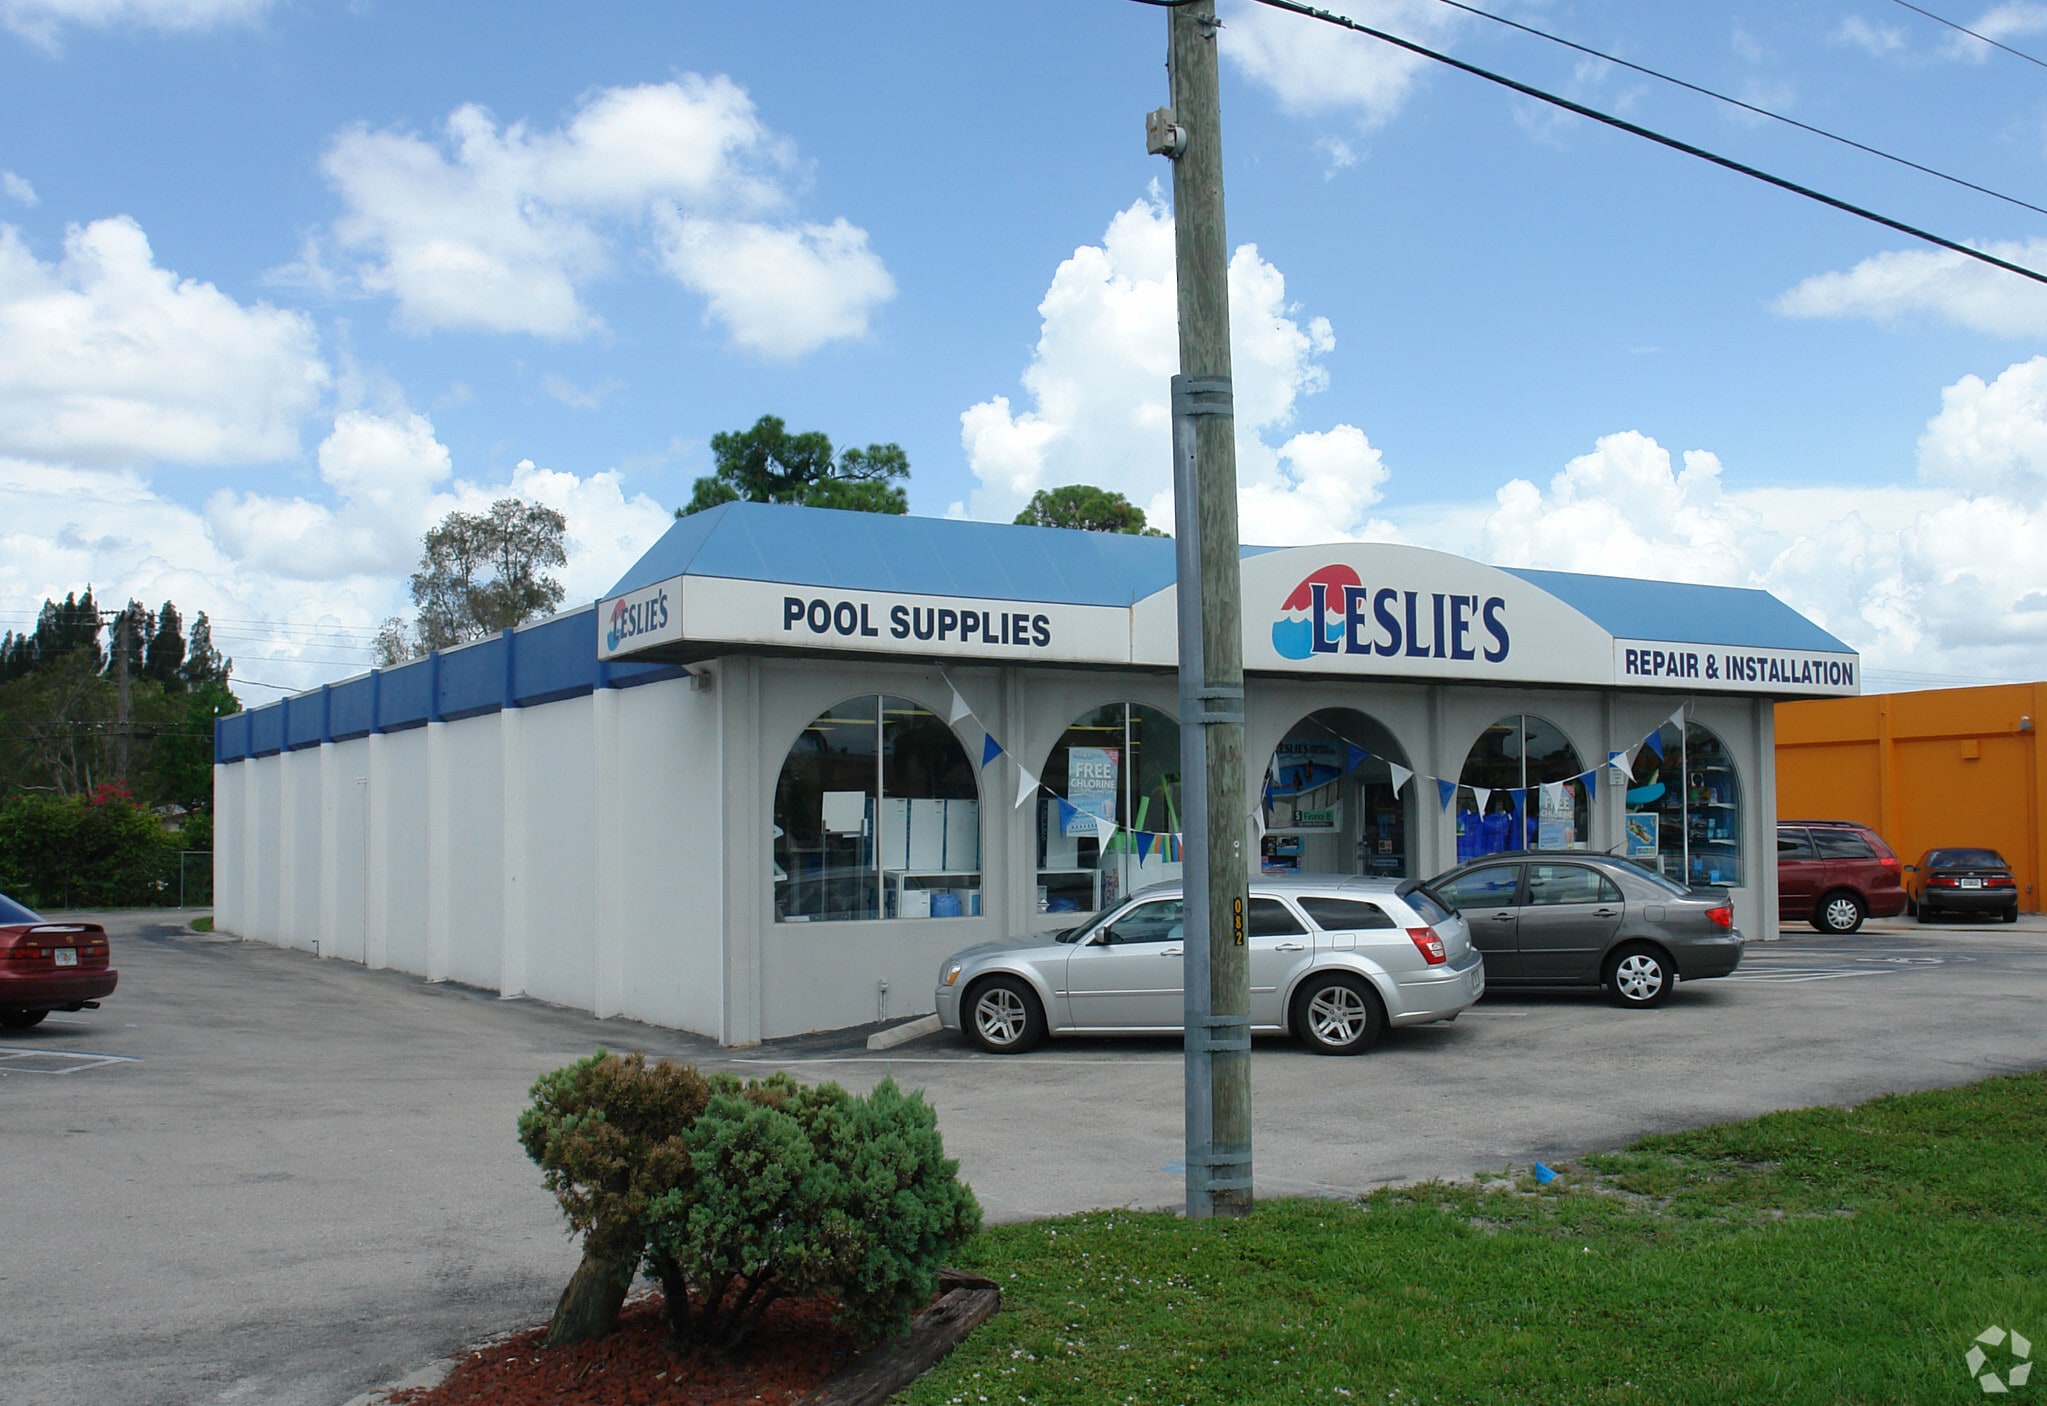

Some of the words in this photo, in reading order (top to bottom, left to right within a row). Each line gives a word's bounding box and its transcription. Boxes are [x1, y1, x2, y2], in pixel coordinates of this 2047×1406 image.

[612, 588, 668, 641] LESLIE'S
[783, 596, 879, 637] POOL
[890, 604, 1051, 647] SUPPLIES
[1310, 583, 1510, 663] LESLIE'S
[1625, 648, 1699, 679] REPAIR
[1705, 653, 1719, 680] &
[1726, 655, 1854, 686] INSTALLATION
[1276, 742, 1309, 755] ESLIE'S
[1070, 778, 1116, 789] CHLORINE
[1075, 762, 1112, 779] FREE
[1234, 898, 1243, 946] 082
